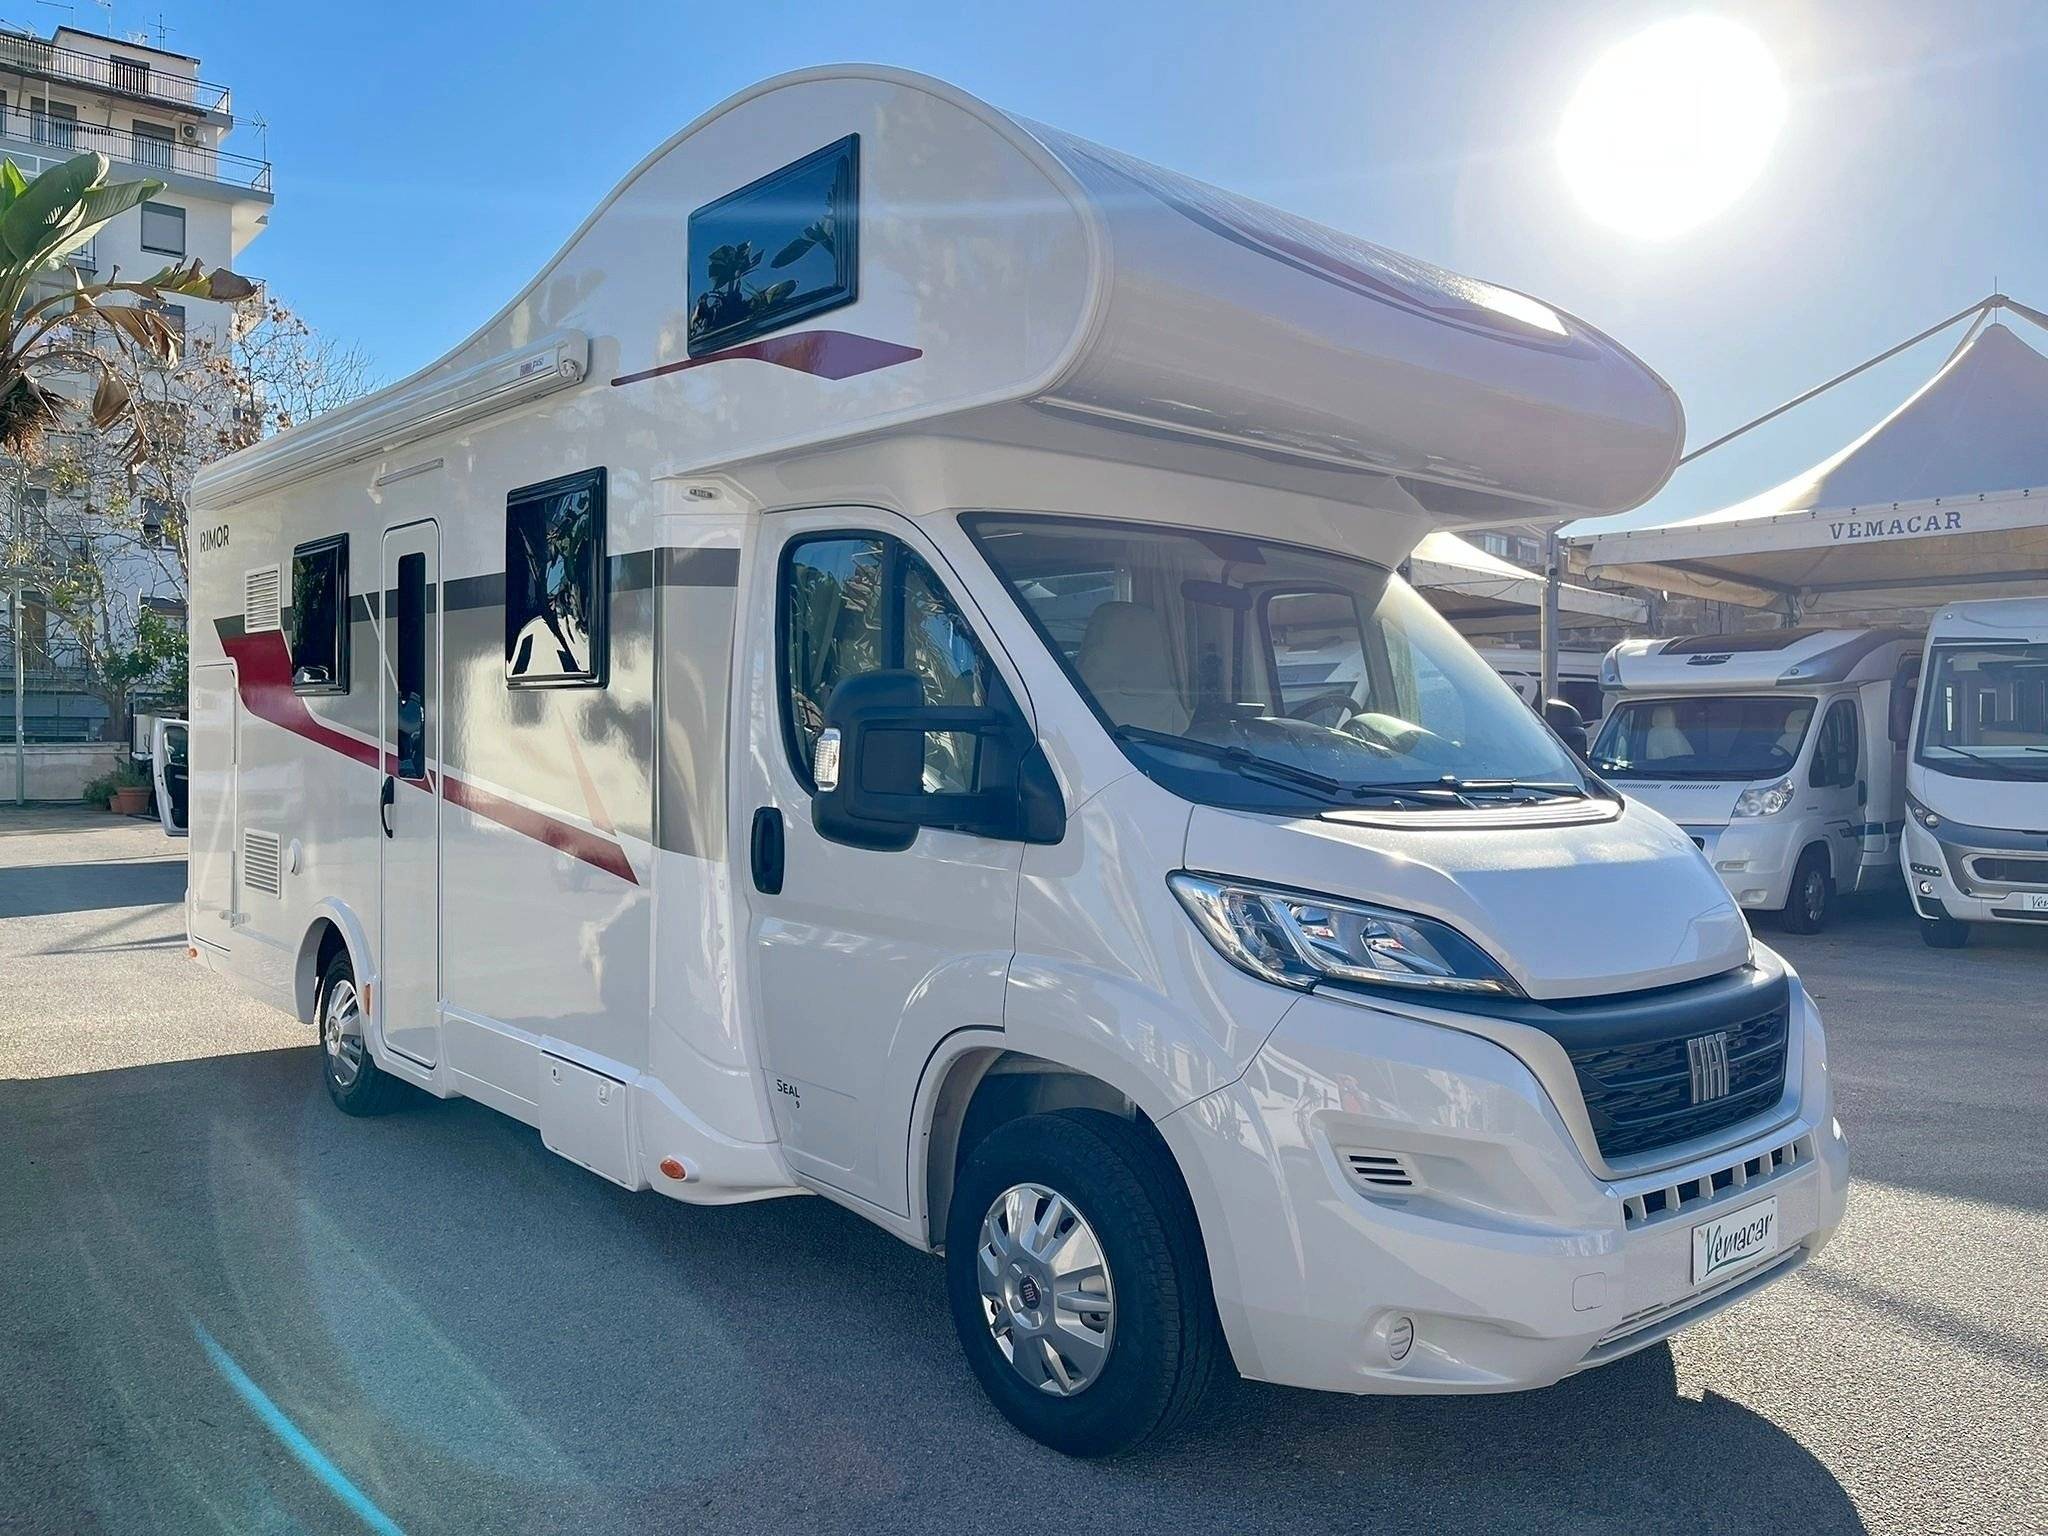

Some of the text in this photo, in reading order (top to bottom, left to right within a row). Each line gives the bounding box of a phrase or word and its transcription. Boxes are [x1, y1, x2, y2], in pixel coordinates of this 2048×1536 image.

[200, 524, 229, 553] RIMOR
[1829, 511, 1962, 540] VEMACAR
[1687, 1031, 1729, 1104] FIAT
[776, 1078, 800, 1098] SEAL
[1706, 1213, 1774, 1273] Vemacar
[1023, 1283, 1036, 1302] FIAT
